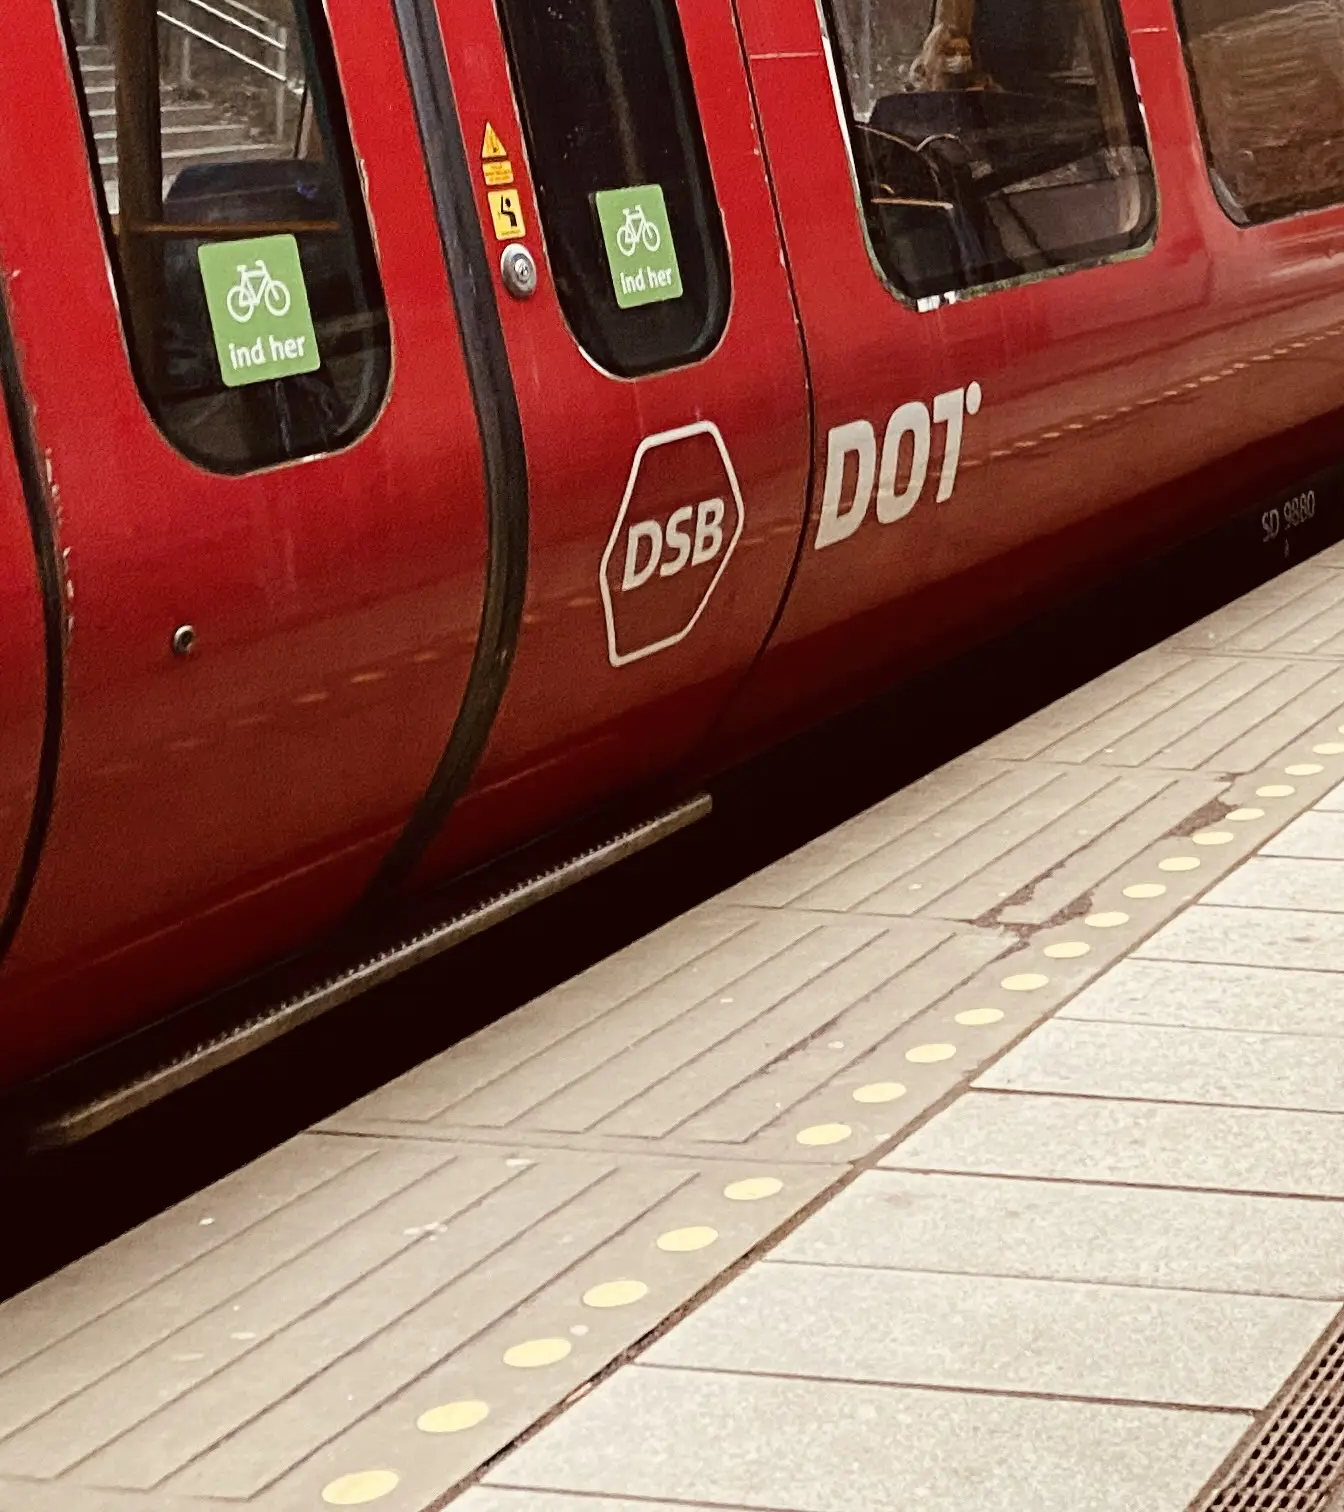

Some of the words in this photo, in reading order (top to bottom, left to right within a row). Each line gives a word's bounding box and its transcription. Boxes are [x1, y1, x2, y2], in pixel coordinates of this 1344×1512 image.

[646, 266, 672, 289] her
[228, 336, 266, 371] ind
[268, 334, 306, 362] her
[814, 386, 968, 551] DOT
[622, 497, 725, 592] DSB
